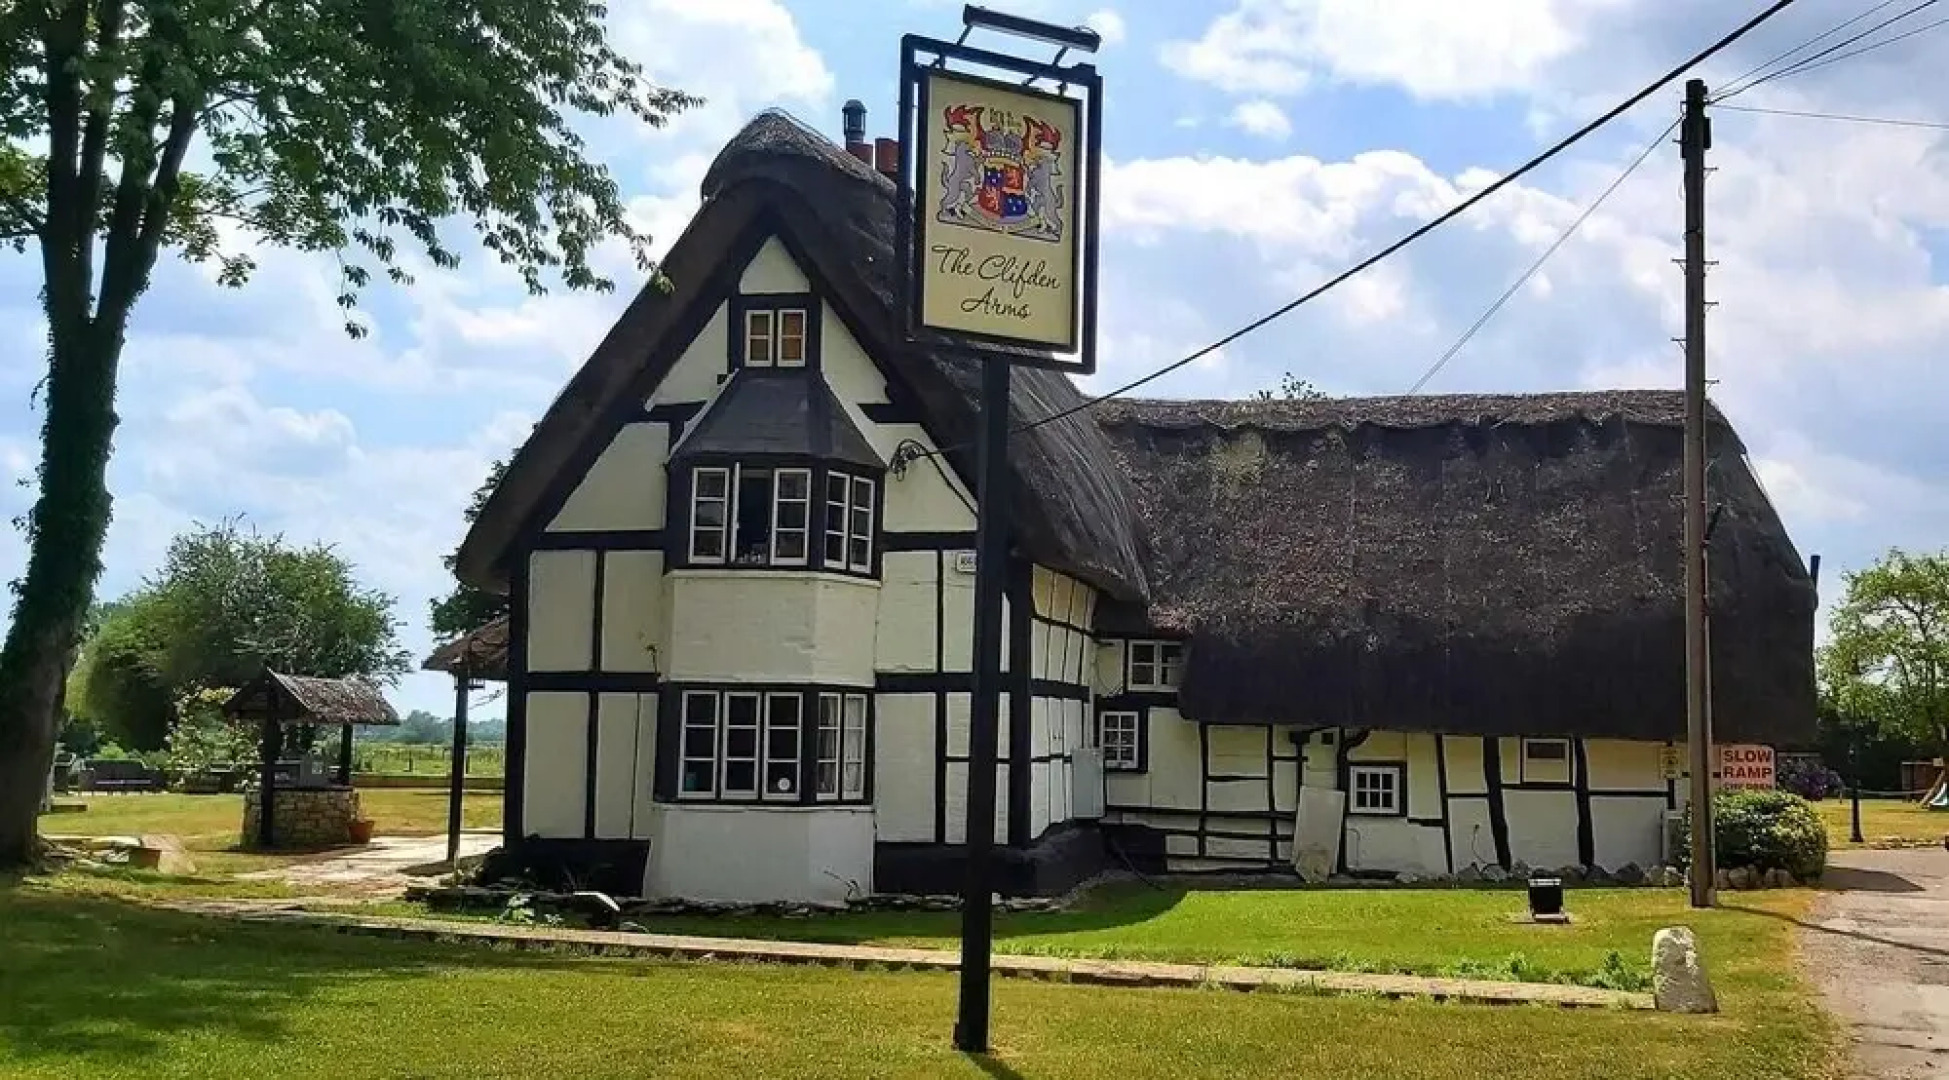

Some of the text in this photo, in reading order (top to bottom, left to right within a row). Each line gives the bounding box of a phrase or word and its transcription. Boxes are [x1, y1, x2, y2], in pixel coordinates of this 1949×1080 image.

[933, 246, 1060, 298] The Clifden
[962, 288, 1031, 318] Arms
[1723, 750, 1772, 763] SLOW
[1723, 766, 1772, 778] RAMP
